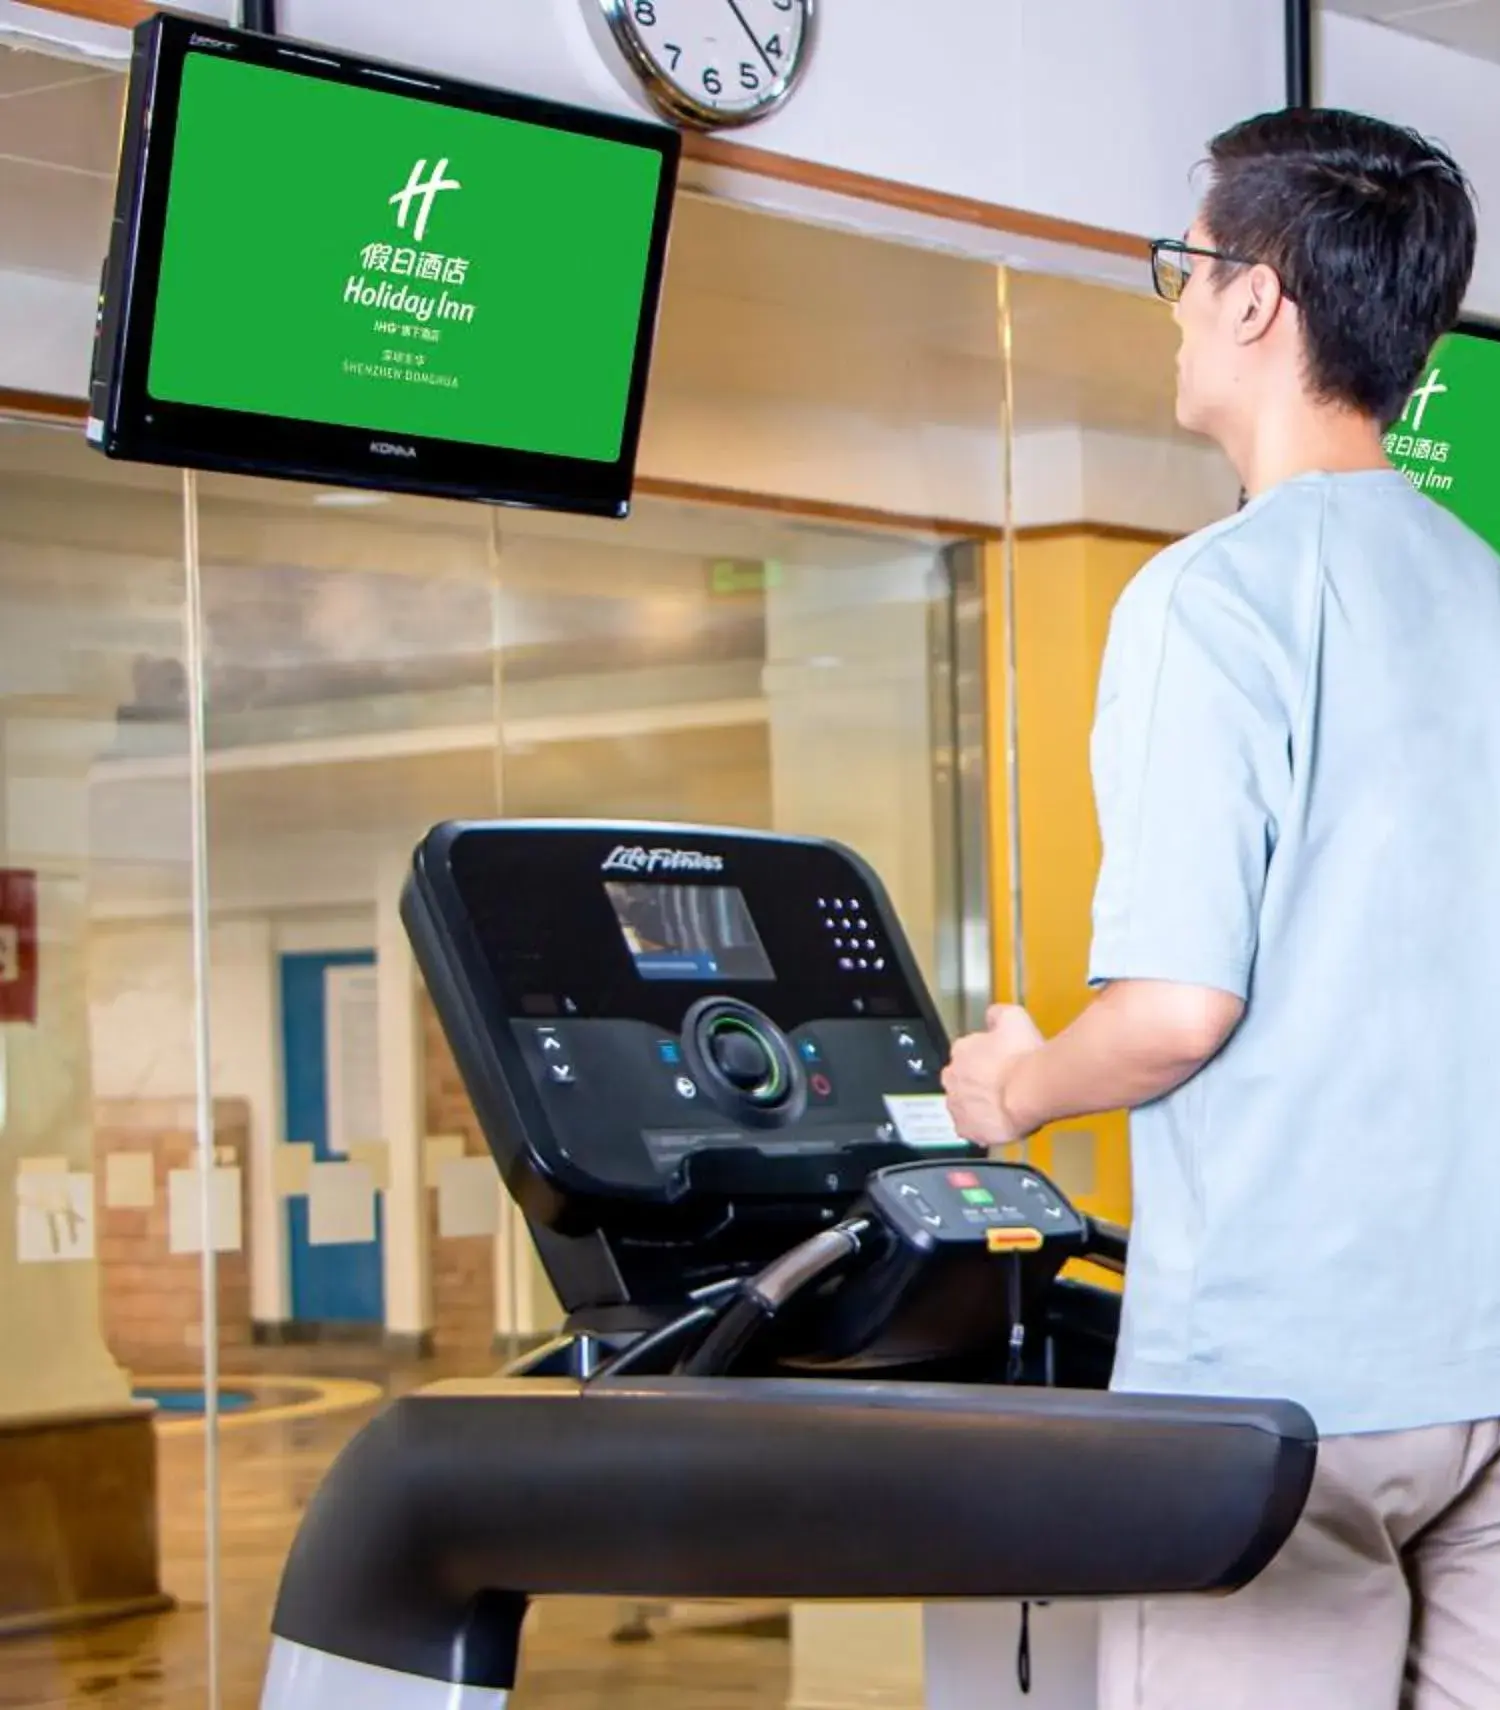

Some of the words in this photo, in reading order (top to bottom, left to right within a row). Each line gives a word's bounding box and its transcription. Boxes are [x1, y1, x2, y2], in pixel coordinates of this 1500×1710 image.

[635, 0, 656, 26] 8
[664, 43, 682, 71] 7
[765, 34, 782, 59] 4
[702, 67, 722, 95] 6
[739, 62, 759, 90] 5
[360, 242, 470, 285] 假日酒店
[343, 275, 435, 321] Holiday
[436, 291, 476, 324] Inn
[1425, 466, 1454, 490] Inn
